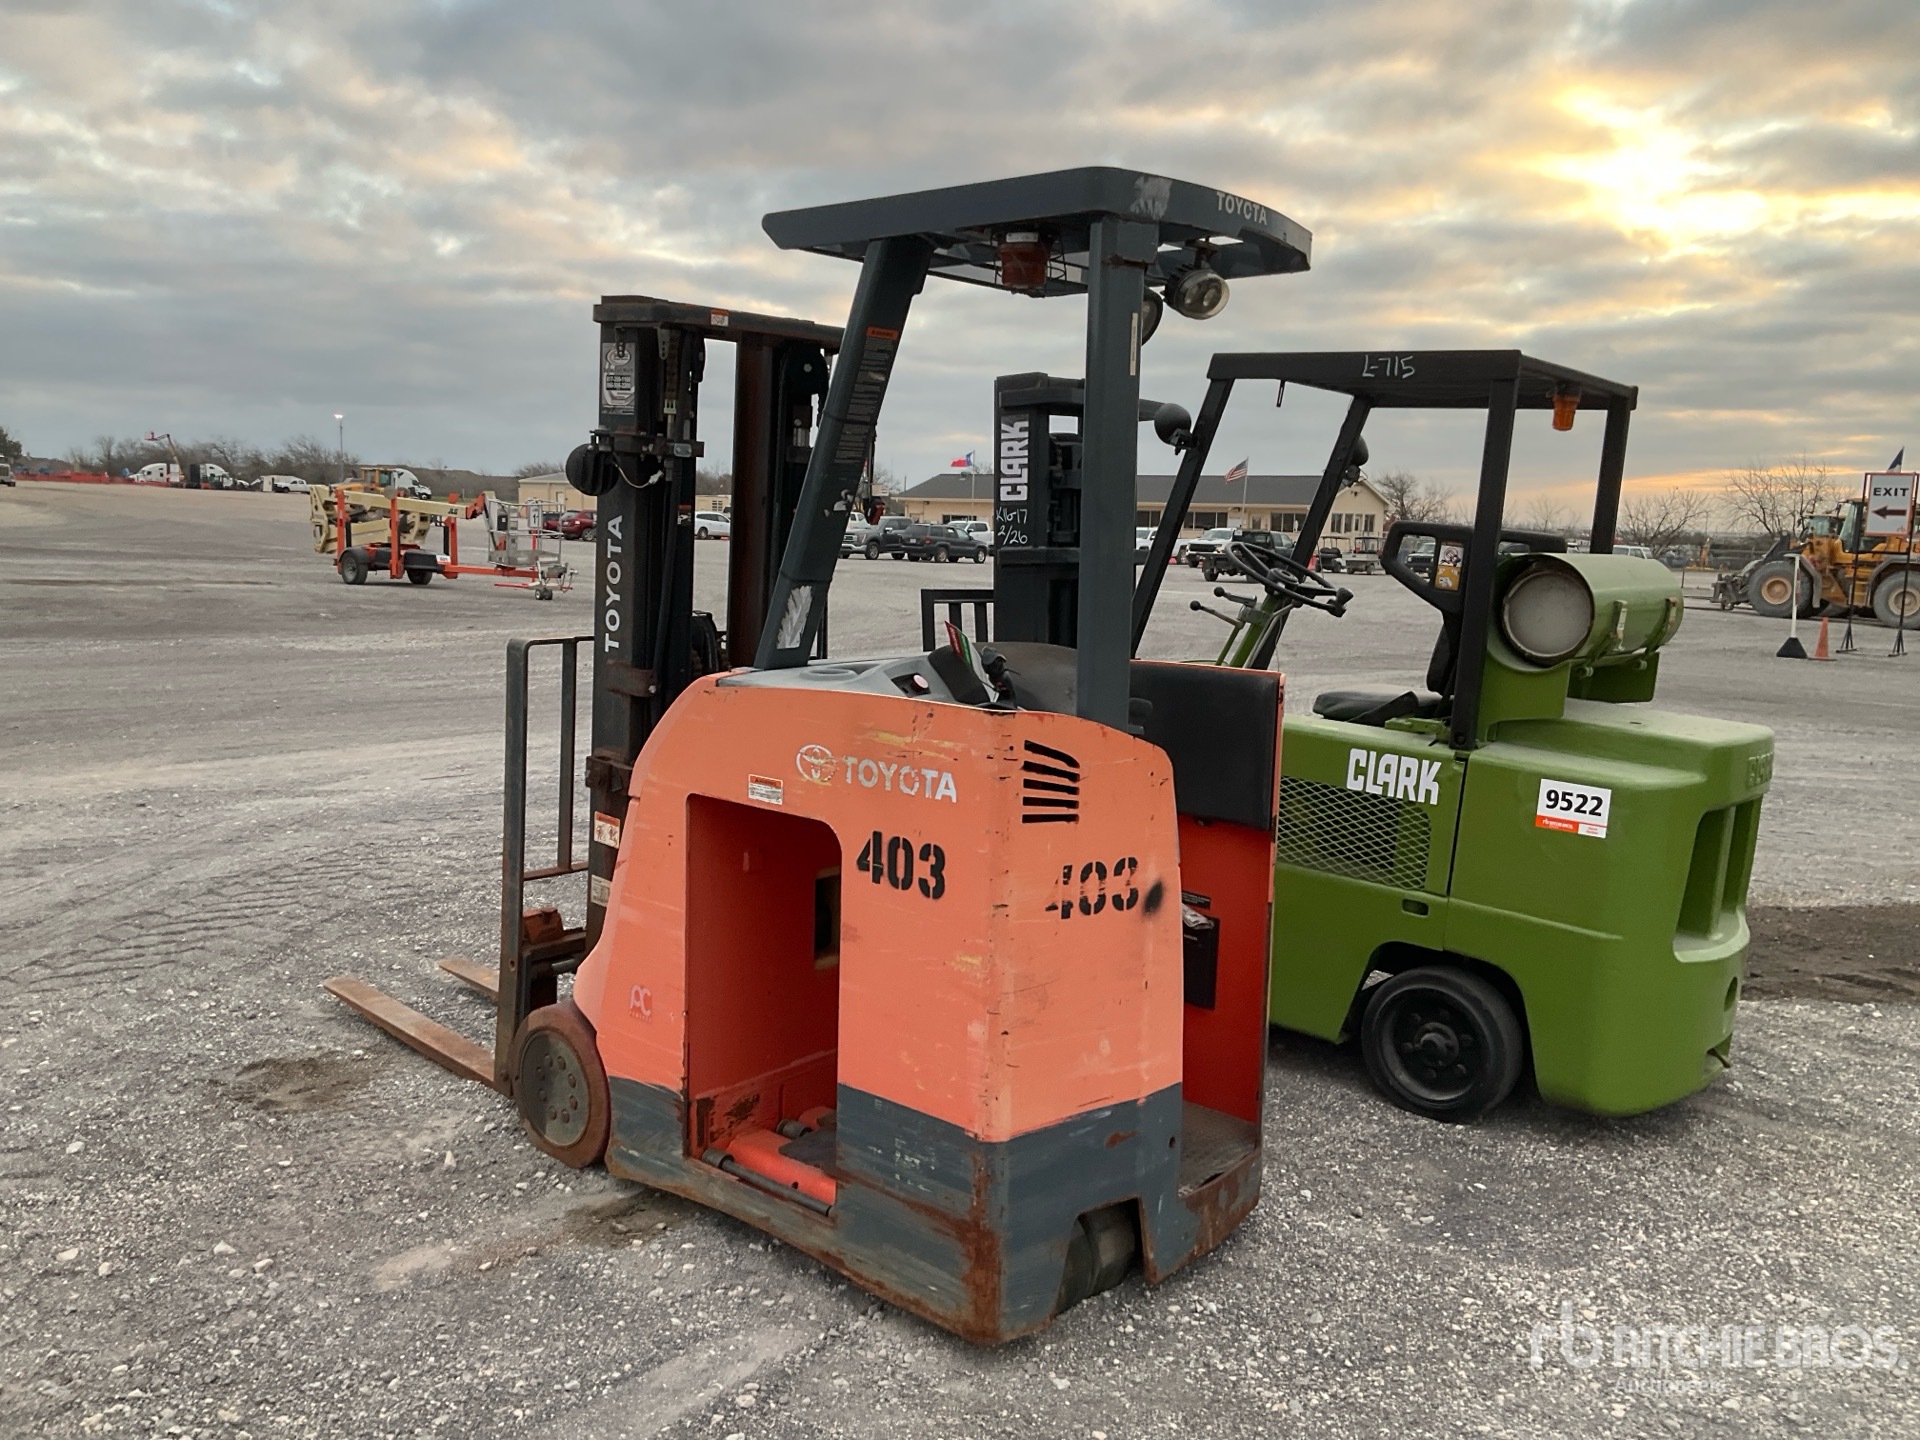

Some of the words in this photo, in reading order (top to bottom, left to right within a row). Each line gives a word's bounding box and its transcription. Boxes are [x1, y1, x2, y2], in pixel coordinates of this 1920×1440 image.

[1216, 190, 1268, 226] TOYOTA
[1362, 354, 1415, 379] L-715
[1000, 421, 1029, 501] CLARK
[1873, 488, 1909, 497] EXIT
[604, 515, 623, 653] TOYOTA
[842, 756, 957, 803] TOYOTA
[1346, 748, 1442, 806] CLARK
[1545, 789, 1603, 817] 9522
[855, 830, 946, 900] 403
[1045, 856, 1139, 920] 403
